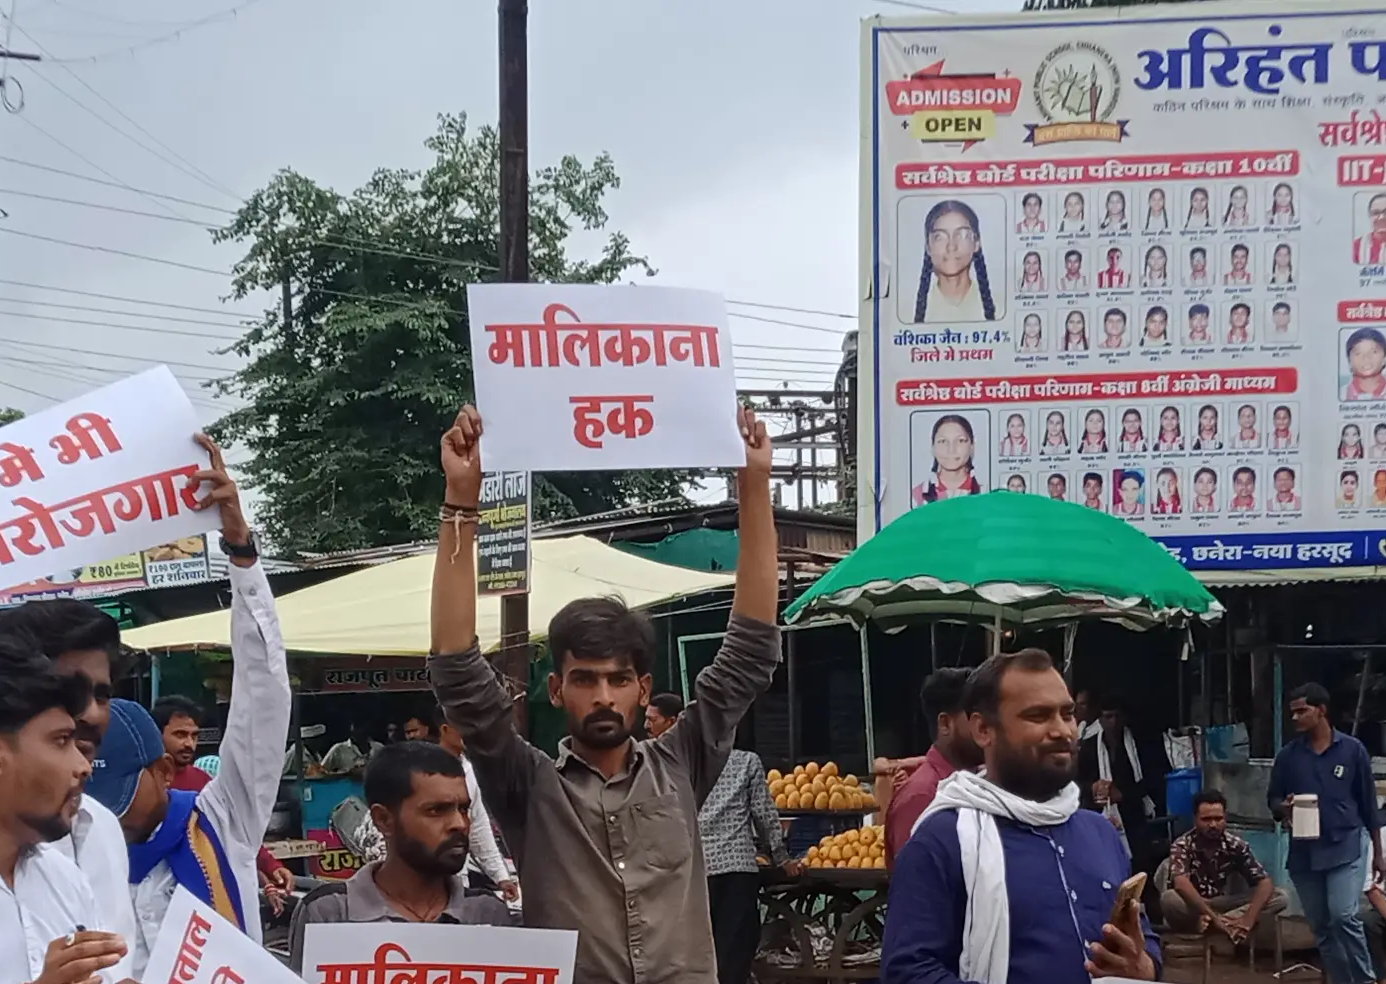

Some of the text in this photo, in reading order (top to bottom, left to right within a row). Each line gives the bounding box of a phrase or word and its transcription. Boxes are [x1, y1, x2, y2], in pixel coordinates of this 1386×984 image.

[1134, 24, 1333, 95] अरिहंत
[897, 87, 1012, 106] ADMISSION
[925, 116, 982, 133] OPEN
[484, 302, 722, 369] मालिकाना
[894, 329, 938, 346] वंशिका
[939, 328, 963, 346] जैन
[910, 346, 943, 363] जिले
[959, 346, 994, 363] प्रथम
[984, 379, 1031, 400] परीक्षा
[1223, 373, 1277, 391] माध्यम
[569, 395, 655, 449] हक
[48, 412, 125, 466] भी
[1296, 541, 1353, 564] हरसूद
[167, 569, 206, 583] शनिवार
[325, 668, 389, 690] राजपूत
